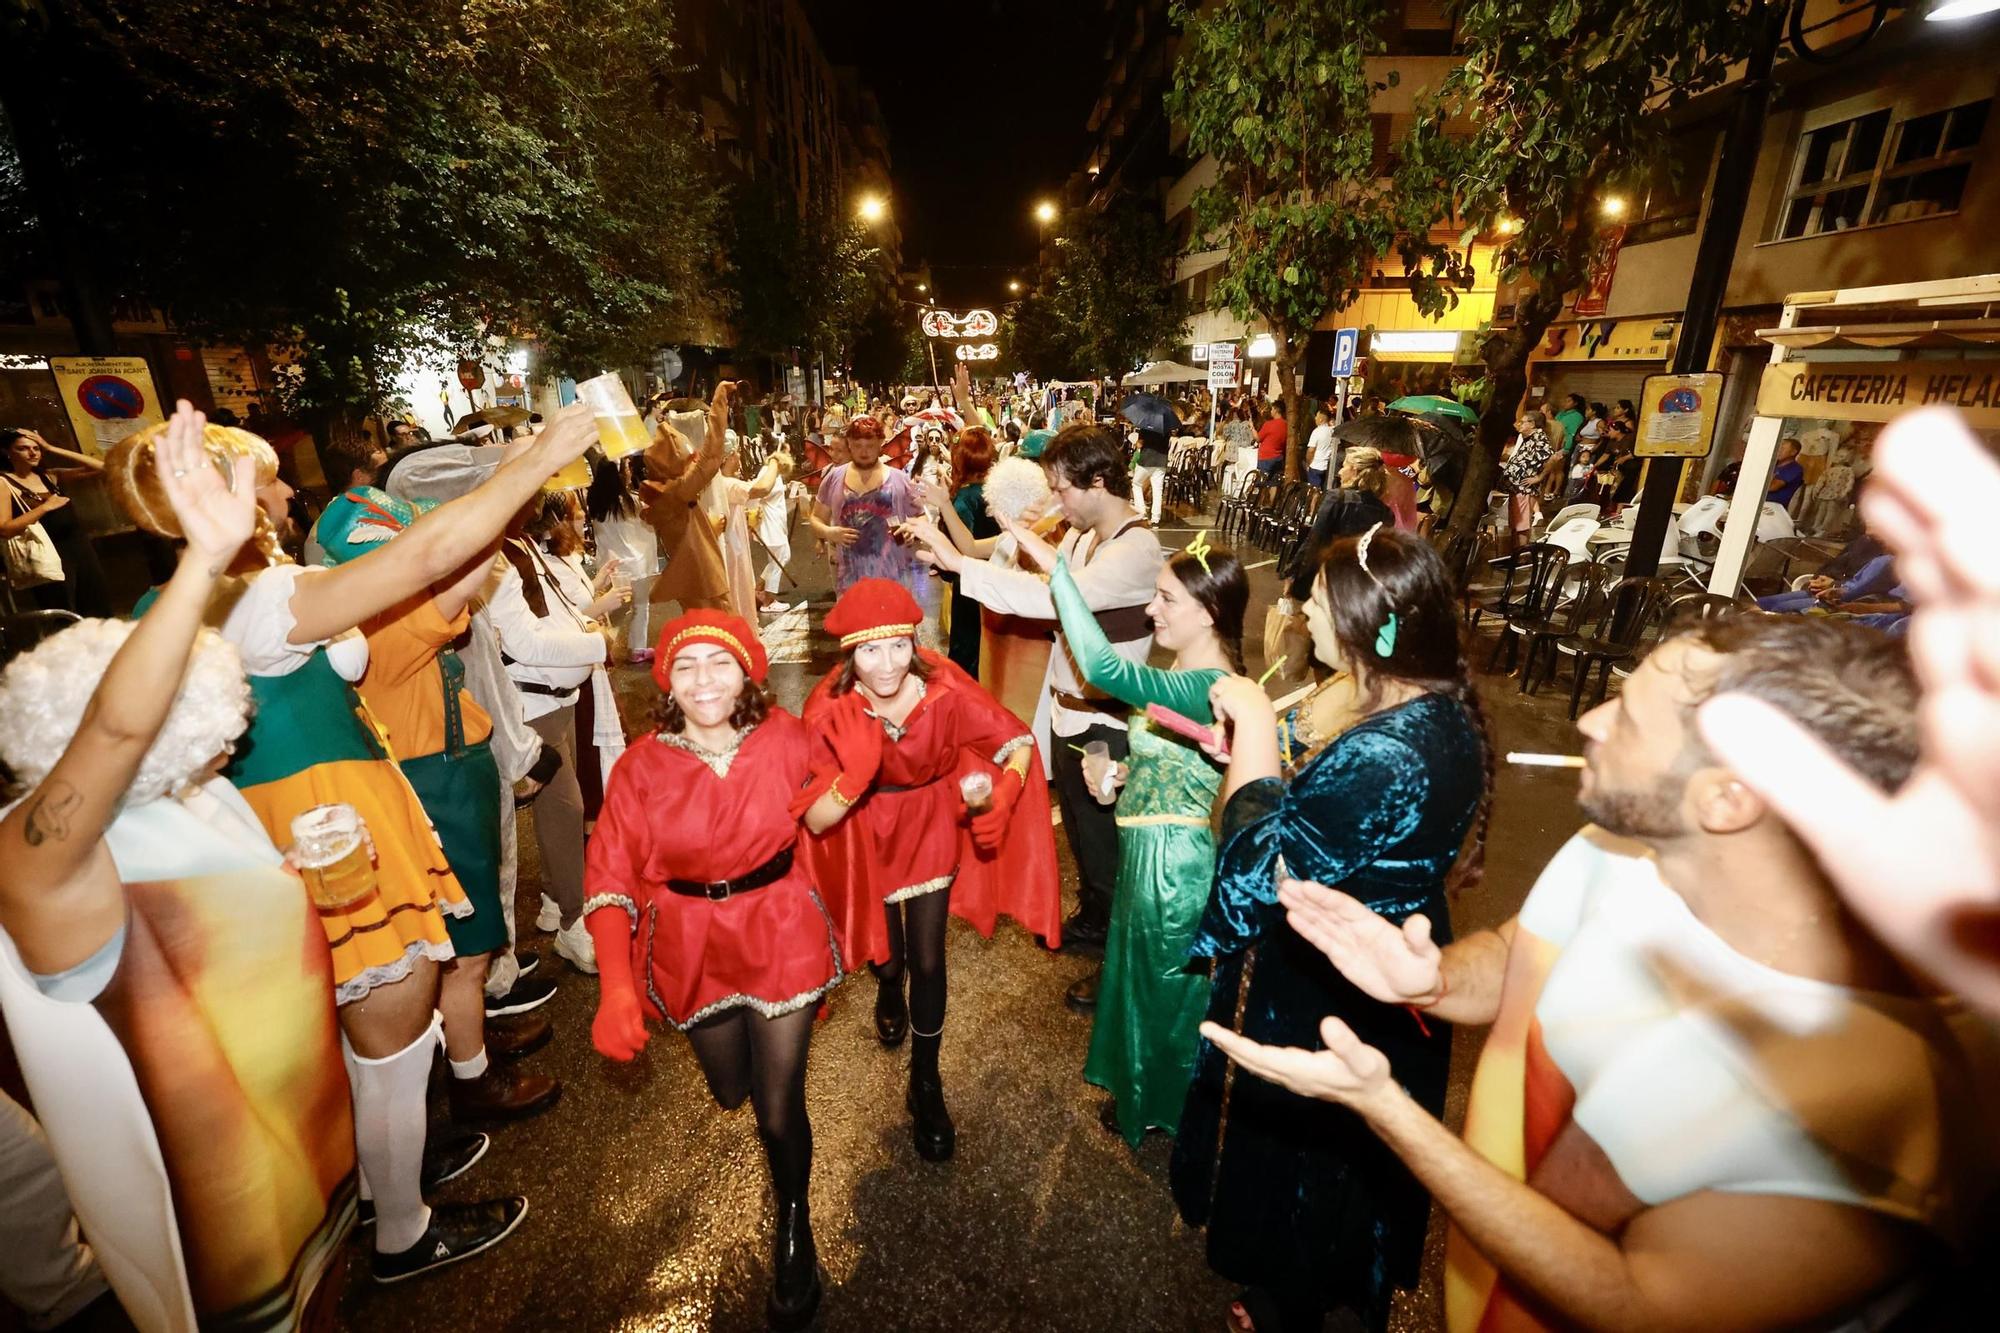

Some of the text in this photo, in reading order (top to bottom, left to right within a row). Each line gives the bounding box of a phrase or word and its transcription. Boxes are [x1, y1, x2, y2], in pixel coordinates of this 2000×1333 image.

[1337, 335, 1352, 371] P
[1545, 328, 1567, 356] 3
[1790, 373, 1907, 405] CAFETERIA
